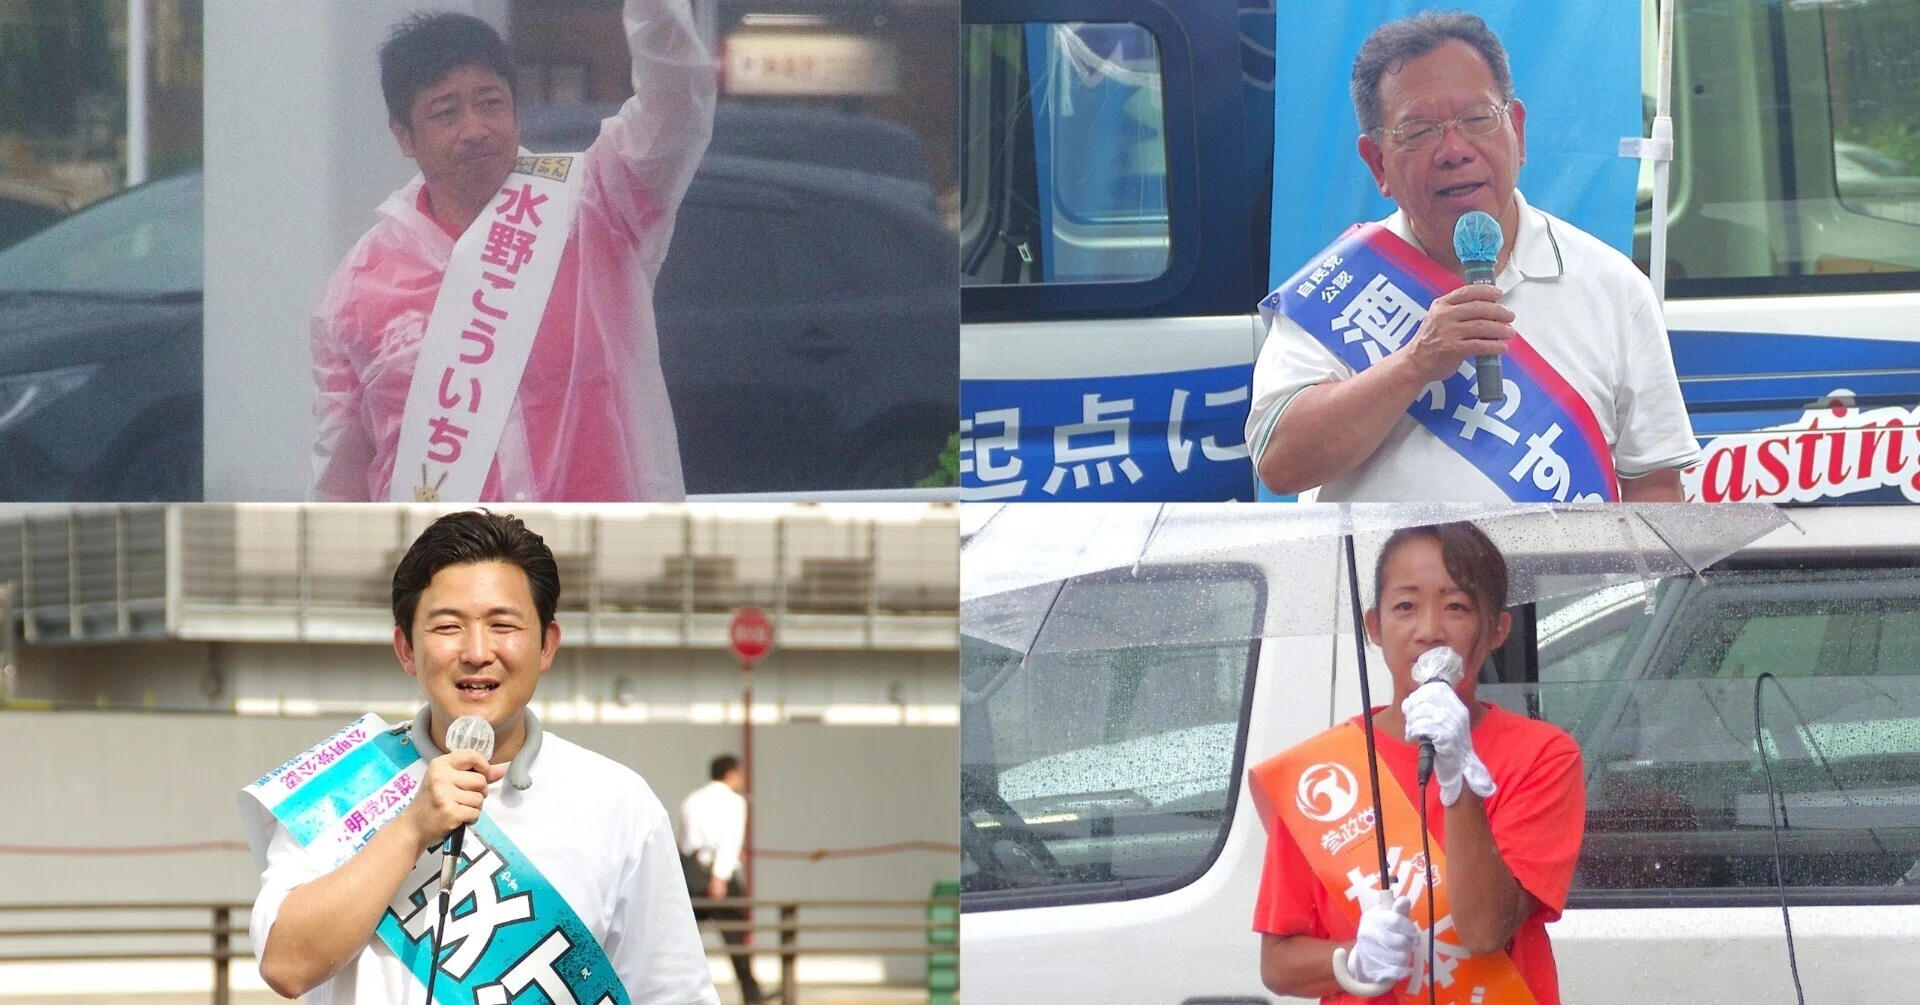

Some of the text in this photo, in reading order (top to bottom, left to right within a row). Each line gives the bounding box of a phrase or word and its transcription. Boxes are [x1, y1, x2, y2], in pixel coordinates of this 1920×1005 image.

[1296, 253, 1344, 299] 自民党
[1320, 270, 1355, 305] 公認
[426, 182, 550, 465] 水野こういち
[1331, 272, 1606, 502] 酒やす
[1684, 399, 1920, 503] astin
[279, 728, 367, 791] 公明党公認
[337, 772, 418, 844] 明党公認
[500, 870, 519, 892] やす
